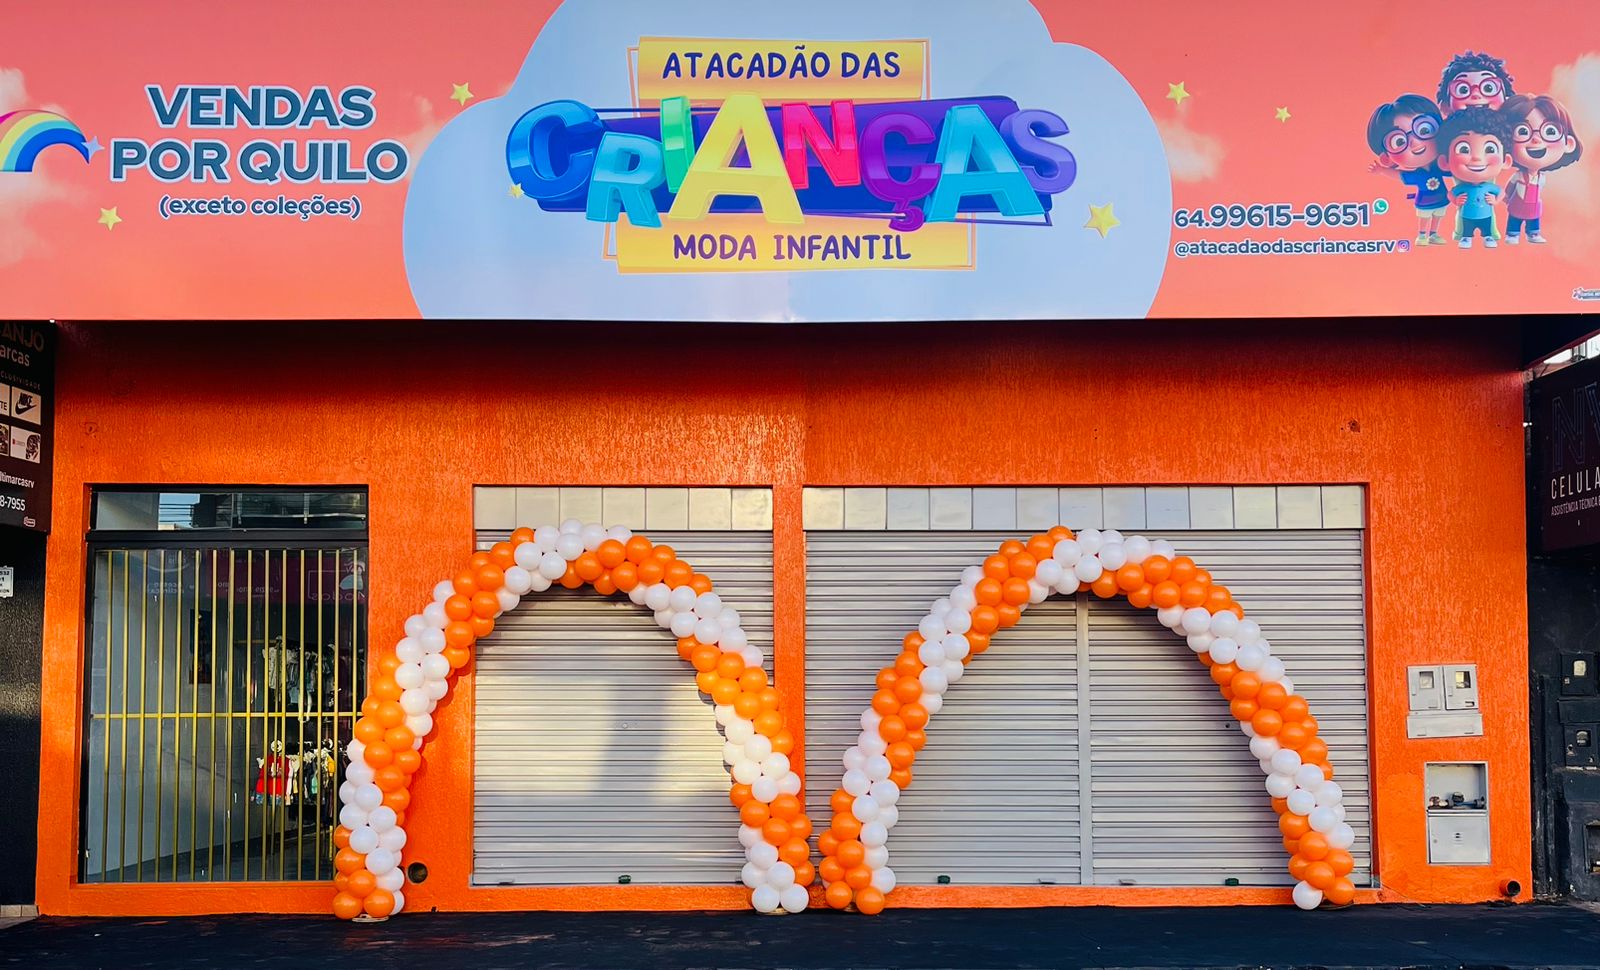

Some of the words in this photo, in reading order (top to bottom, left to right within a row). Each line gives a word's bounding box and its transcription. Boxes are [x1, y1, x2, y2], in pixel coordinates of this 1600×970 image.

[662, 45, 830, 80] ATACADÃO
[841, 51, 901, 80] DAS
[146, 84, 376, 129] VENDAS
[110, 139, 231, 183] POR
[238, 139, 409, 185] QUILO
[505, 91, 1077, 232] CRIANÇAS
[159, 194, 246, 219] (exceto
[251, 193, 361, 220] coleções)
[1174, 203, 1369, 228] 64.99615-9651
[673, 234, 757, 260] MODA
[773, 233, 912, 260] INFANTIL
[1174, 238, 1397, 257] @atacadaodascriancasrv
